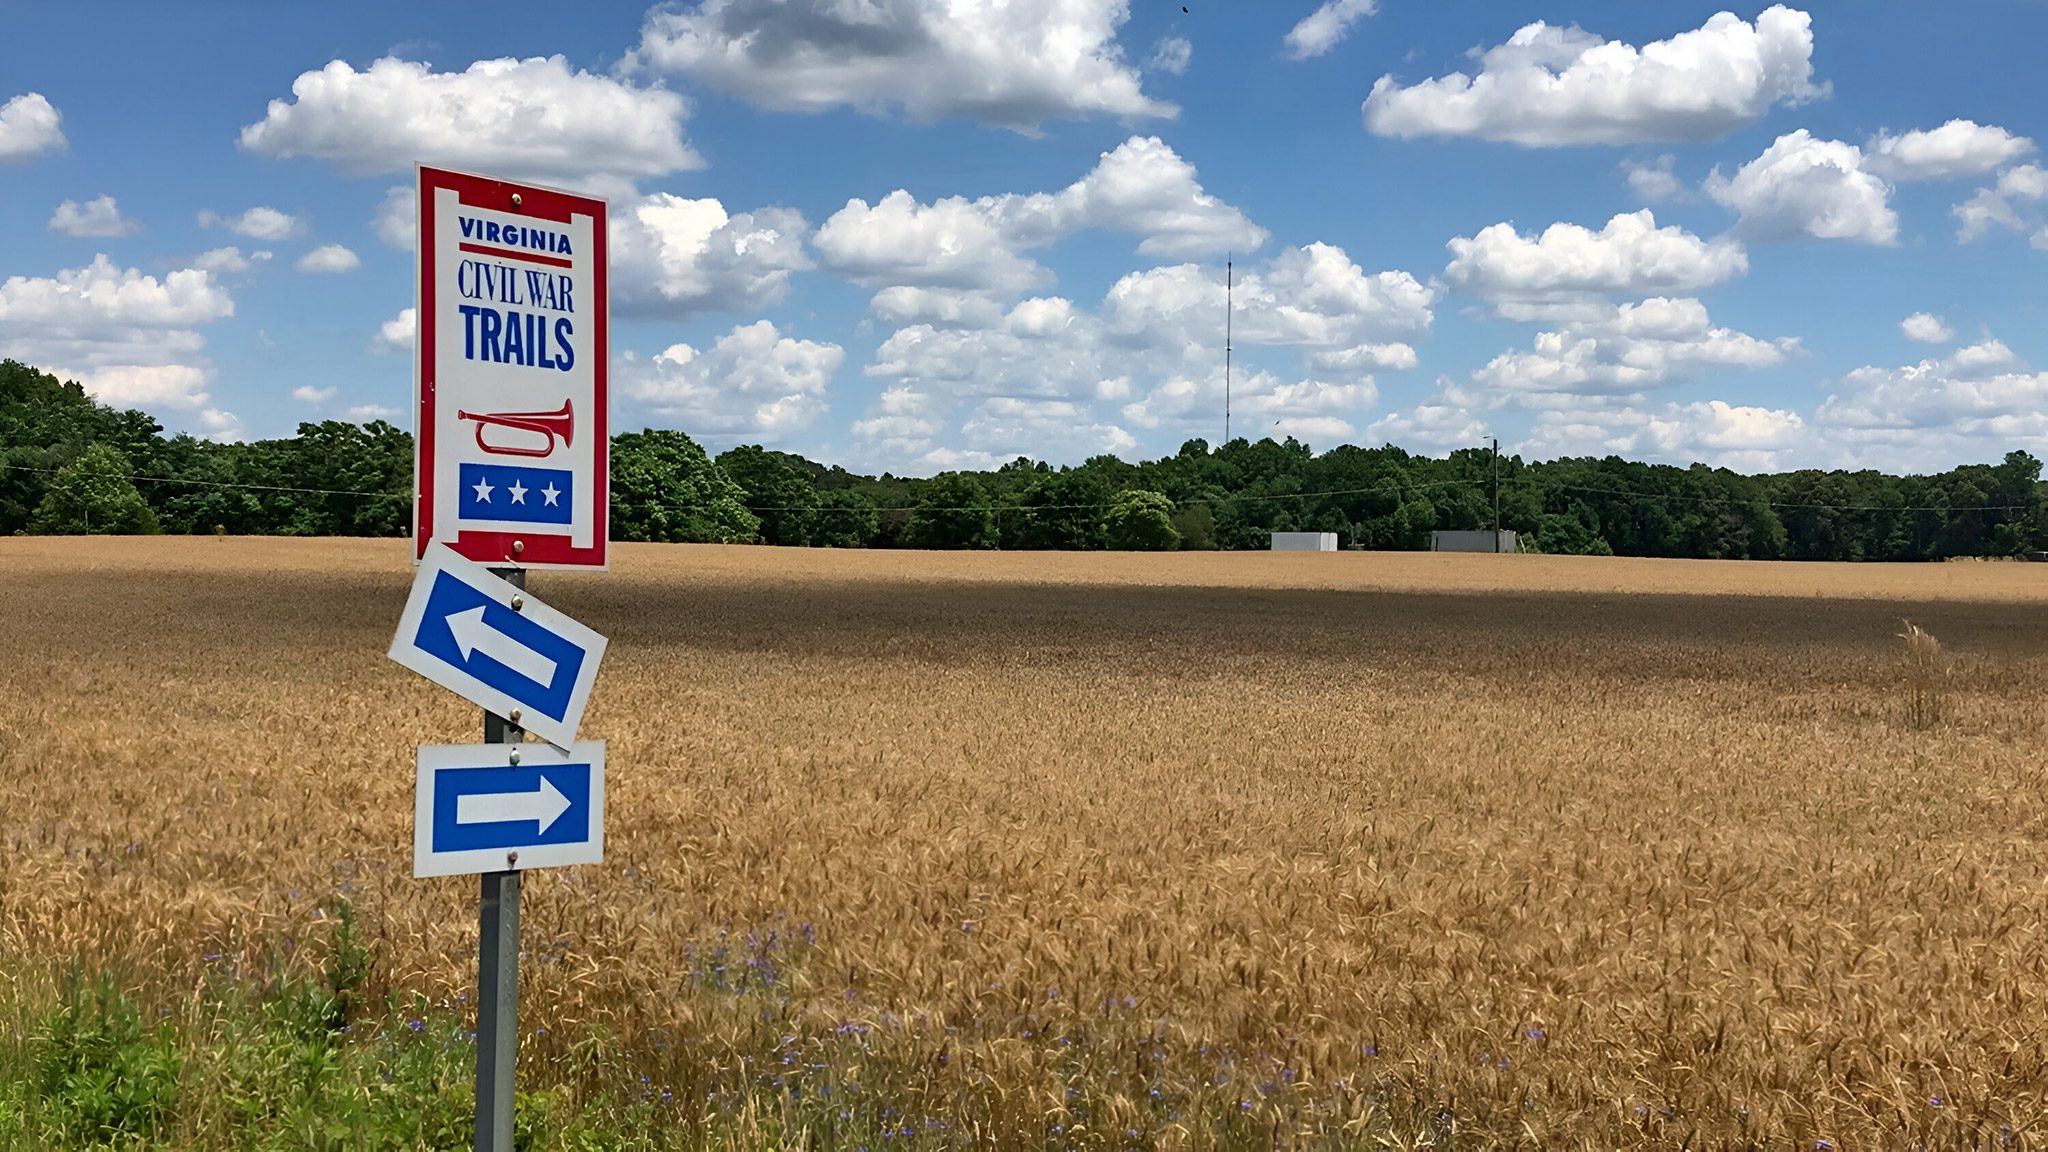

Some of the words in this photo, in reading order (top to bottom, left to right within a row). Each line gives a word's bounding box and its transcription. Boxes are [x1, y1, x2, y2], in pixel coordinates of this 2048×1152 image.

[458, 216, 572, 255] VIRGINIA
[458, 259, 523, 304] CIVIL
[525, 270, 574, 313] WAR
[459, 305, 574, 371] TRAILS
